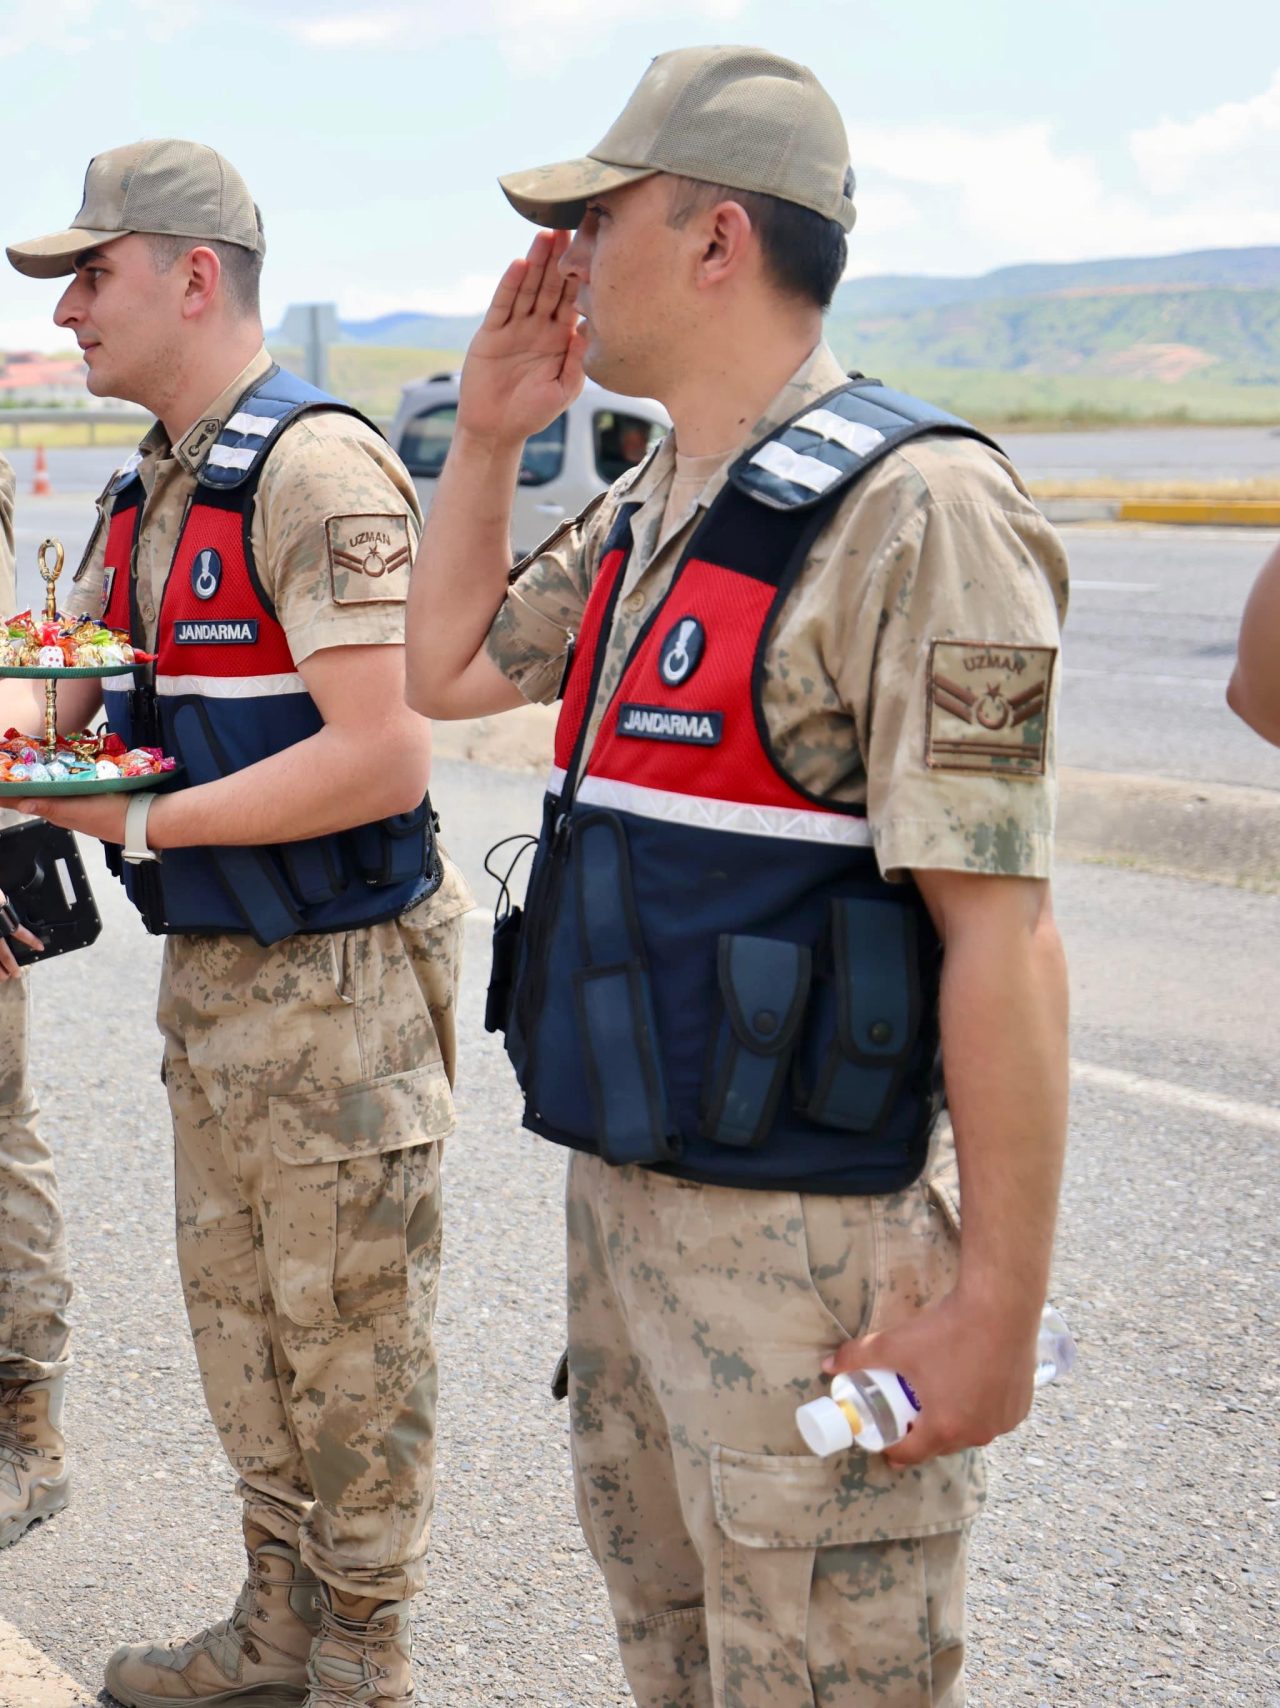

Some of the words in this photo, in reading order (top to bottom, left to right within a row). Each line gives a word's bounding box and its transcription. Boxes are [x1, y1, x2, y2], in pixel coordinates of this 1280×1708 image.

[349, 531, 391, 548] UZMAN
[178, 623, 253, 640] JANDARMA
[962, 654, 1026, 676] UZMAN
[623, 709, 714, 738] JANDARMA
